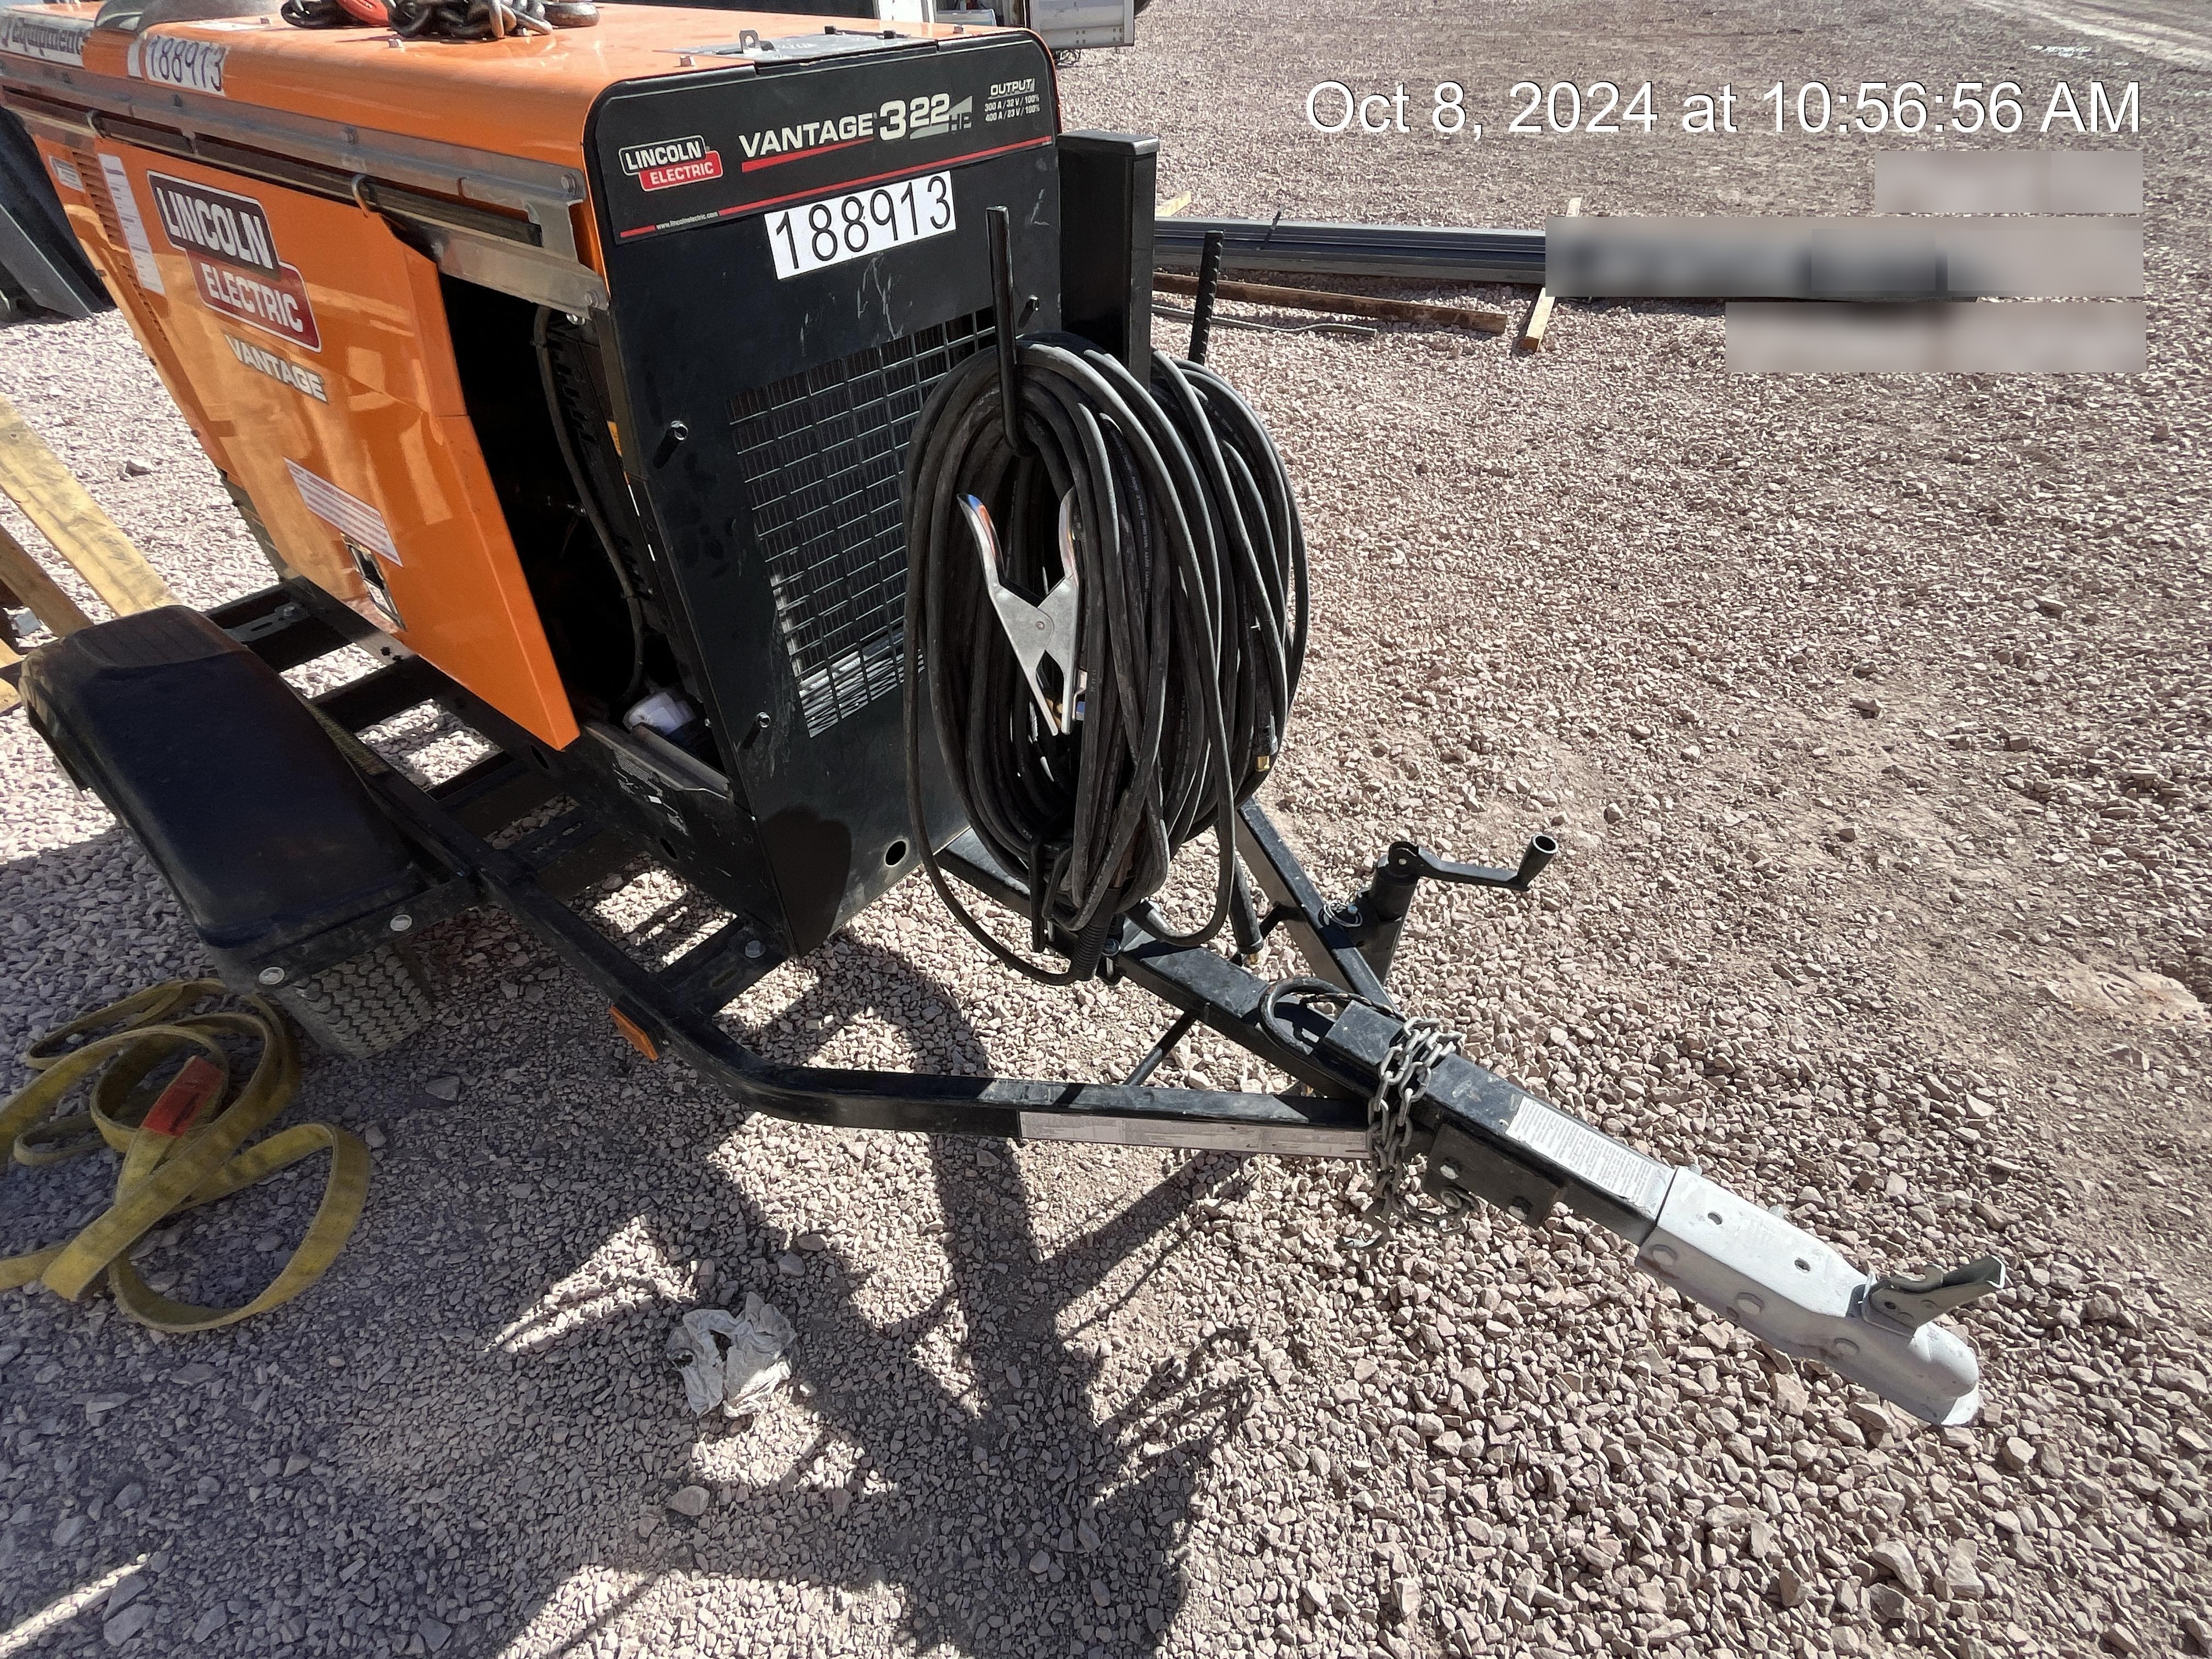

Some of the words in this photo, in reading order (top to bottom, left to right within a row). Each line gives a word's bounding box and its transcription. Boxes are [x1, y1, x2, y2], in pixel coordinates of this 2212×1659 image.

[150, 35, 226, 91] 188913
[985, 102, 996, 112] 300
[990, 78, 1032, 96] OUTPUT
[738, 112, 873, 158] VANTAGE
[879, 93, 950, 140] 322
[985, 112, 997, 122] 400
[625, 140, 702, 170] LINCOLN
[650, 161, 714, 185] ELECTRIC
[156, 187, 274, 269] LINCOLN
[656, 212, 718, 229] www.lincolnelectric.com
[776, 176, 950, 269] 188913
[200, 262, 303, 332] ELECTRIC
[224, 335, 328, 402] VANTAGE
